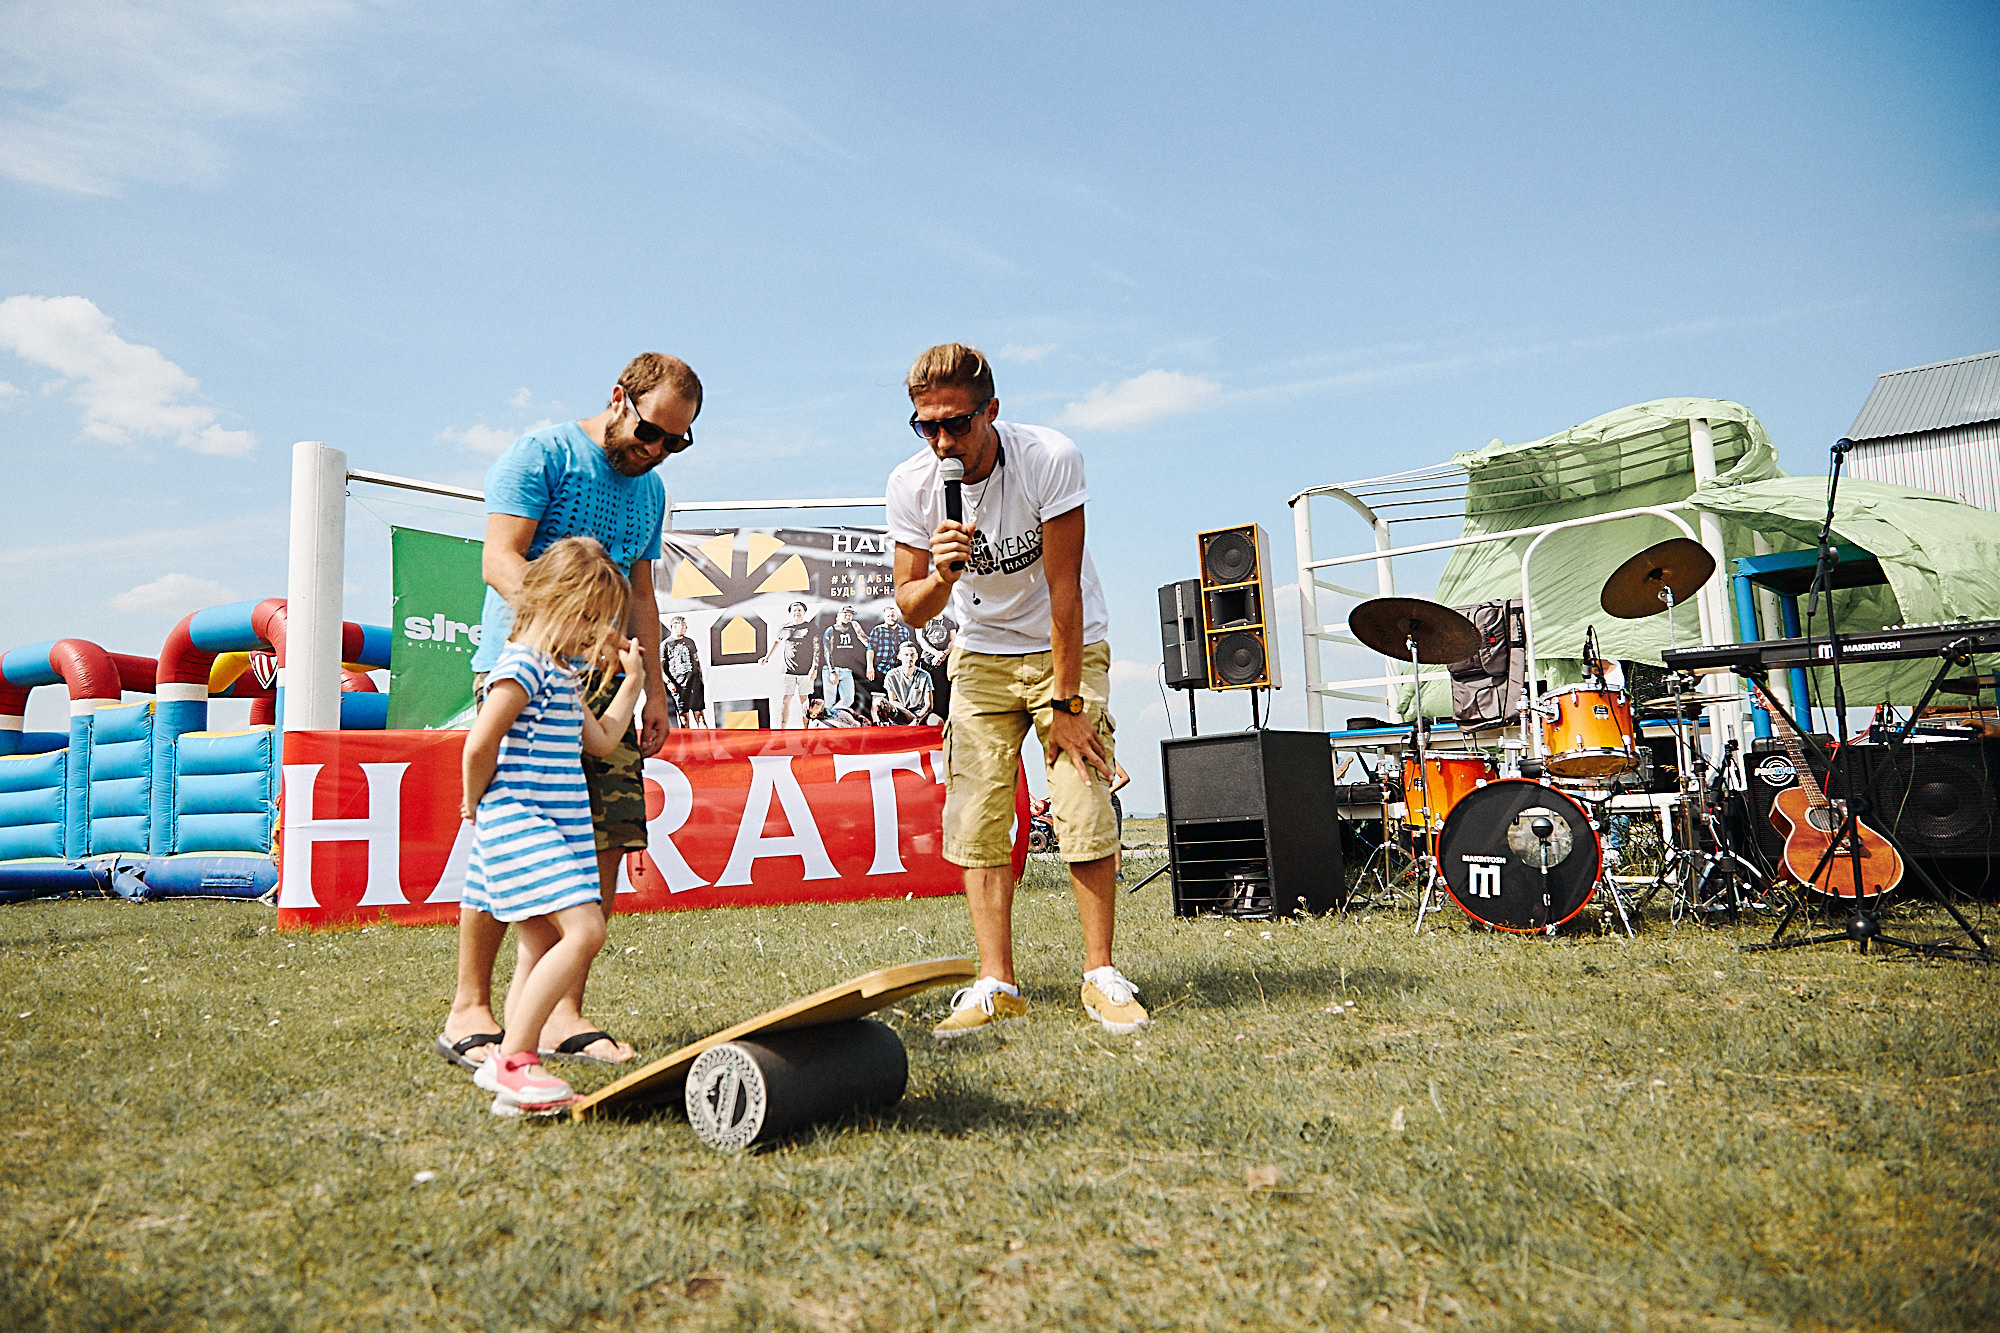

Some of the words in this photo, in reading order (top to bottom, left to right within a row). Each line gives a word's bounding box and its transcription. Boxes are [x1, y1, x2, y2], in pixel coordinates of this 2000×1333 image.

[830, 587, 856, 597] БУДЬ
[1842, 640, 1901, 653] MAKINTOSH
[1461, 854, 1507, 865] MAKINTOSH
